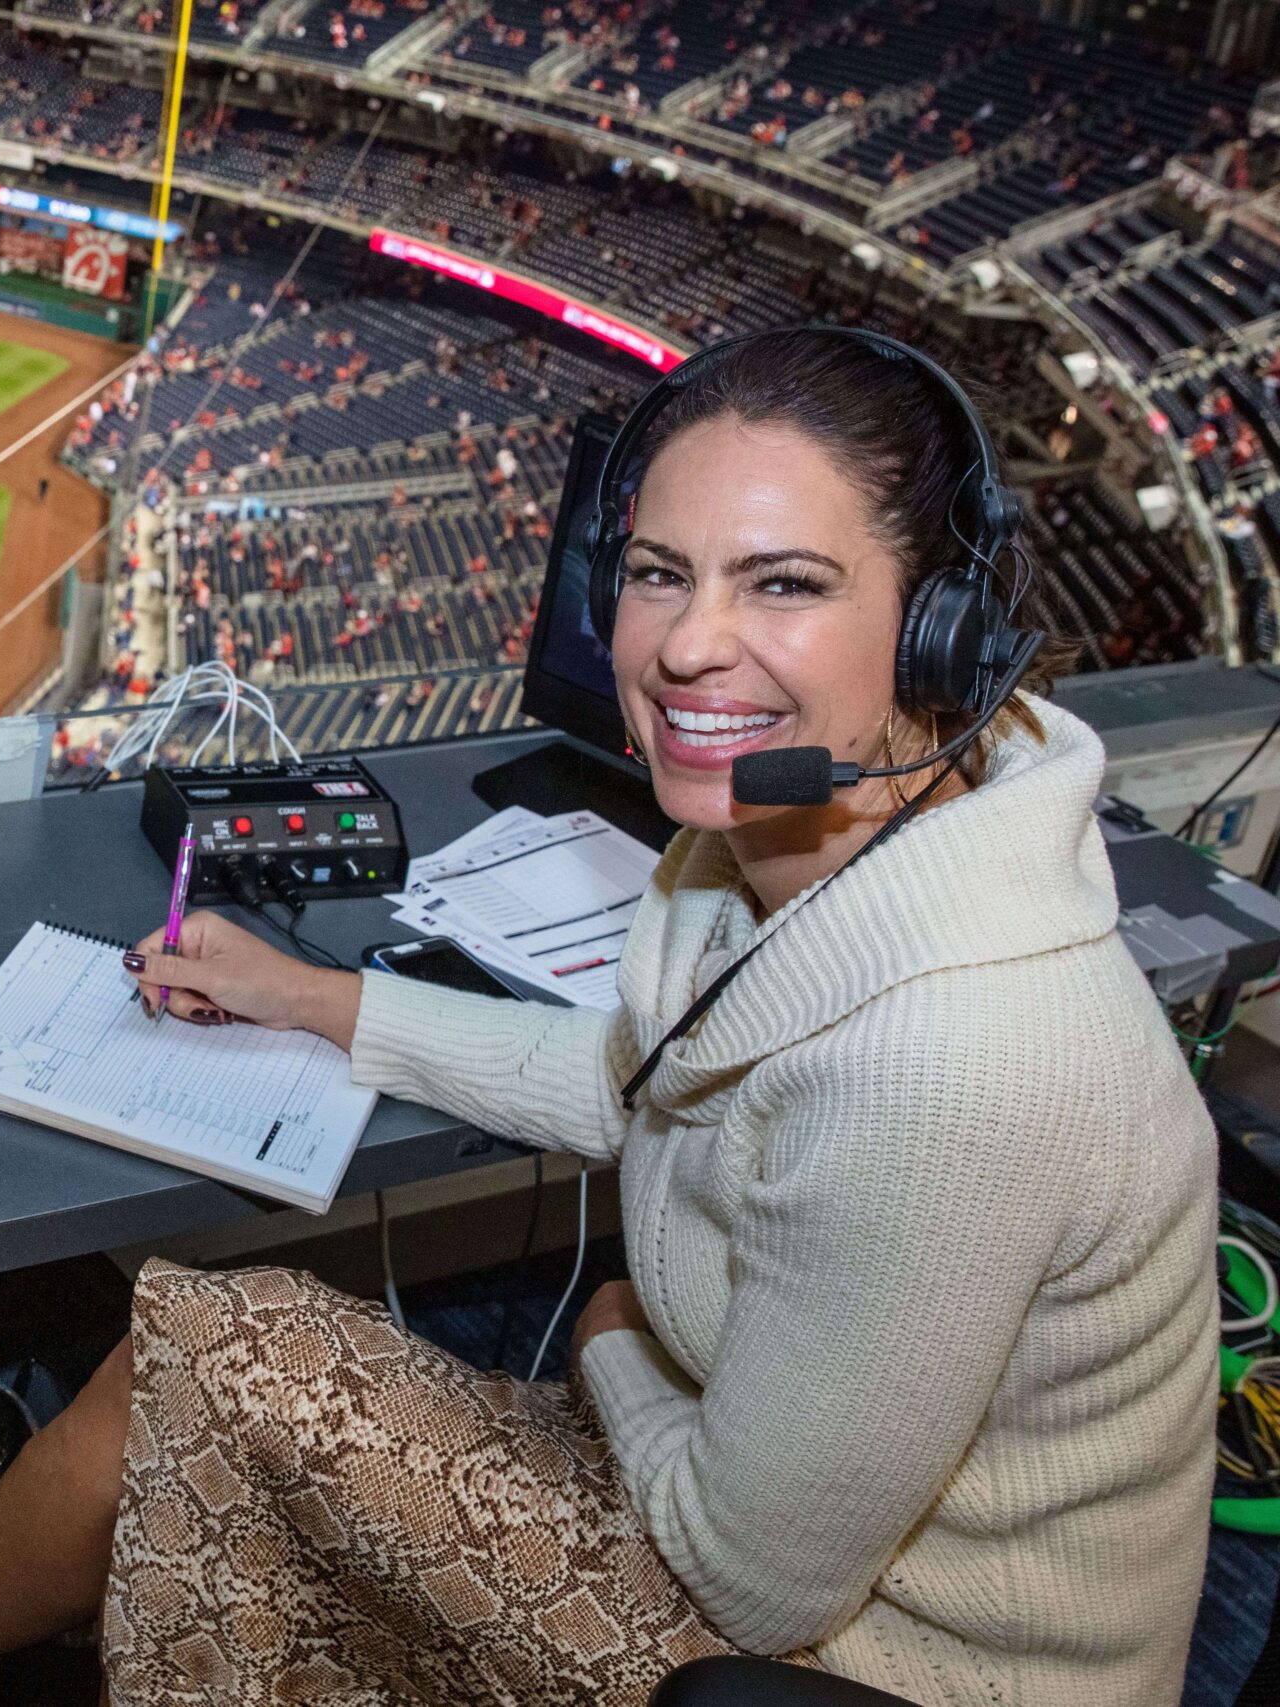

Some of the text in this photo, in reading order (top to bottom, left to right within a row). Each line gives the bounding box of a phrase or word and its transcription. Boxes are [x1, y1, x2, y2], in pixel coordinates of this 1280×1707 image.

[277, 807, 306, 815] COUGH
[355, 814, 376, 822] TALK
[212, 820, 228, 829] MIC
[356, 821, 379, 830] BACK
